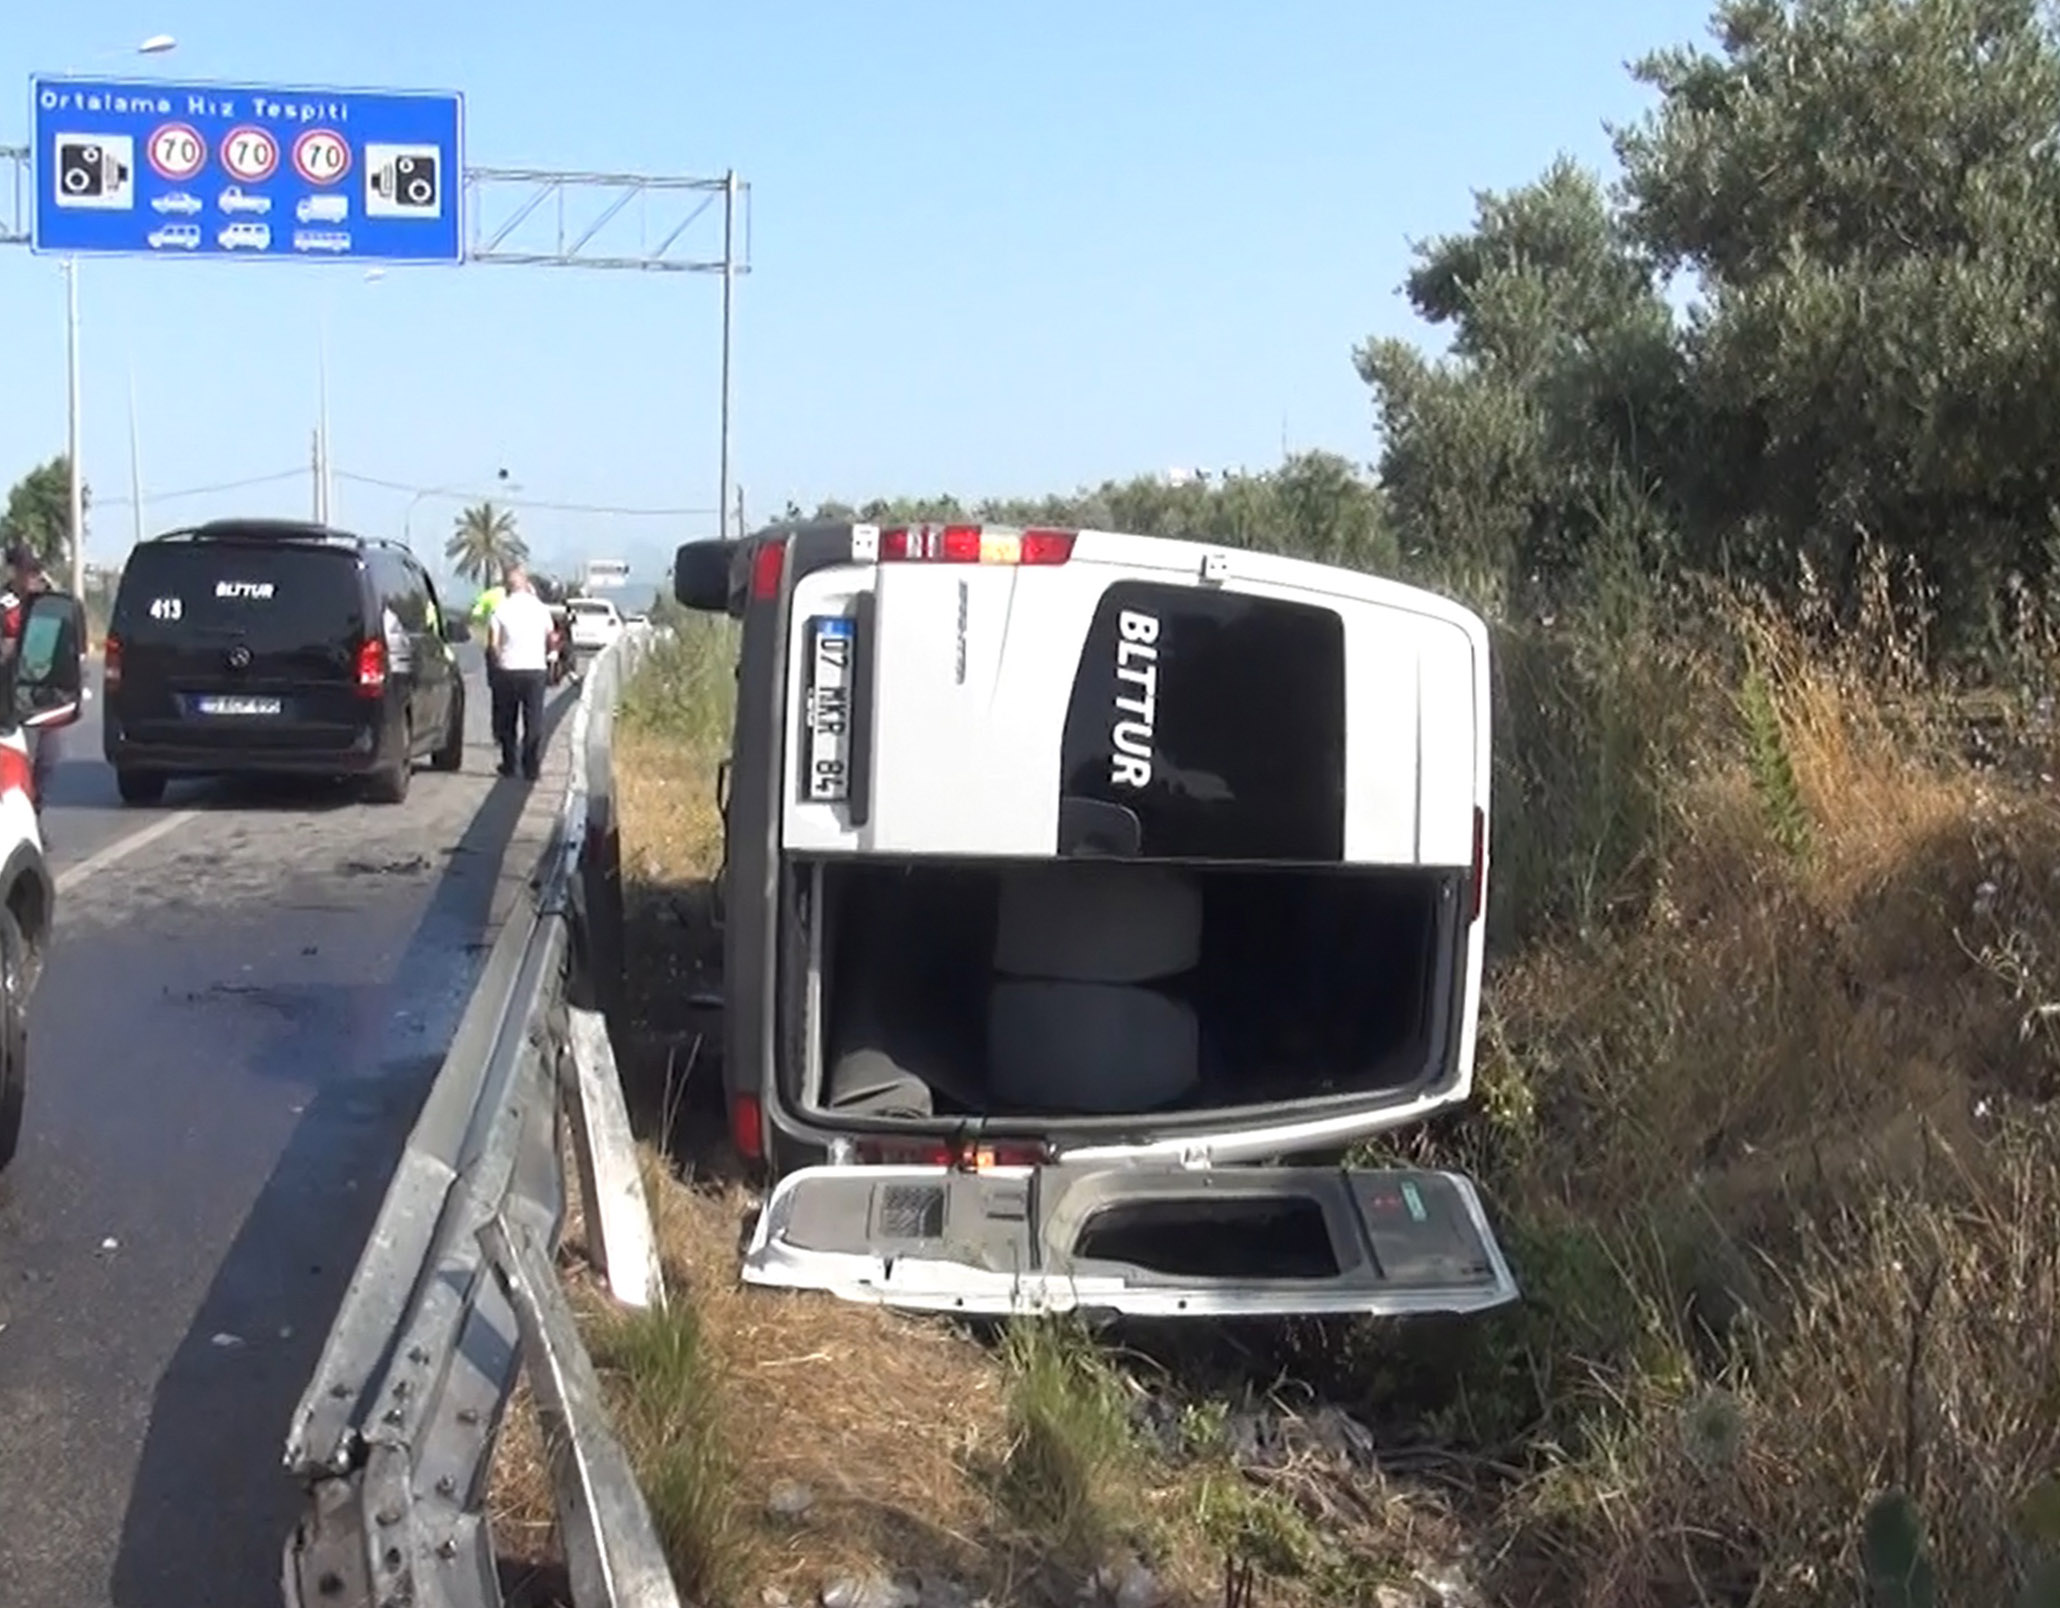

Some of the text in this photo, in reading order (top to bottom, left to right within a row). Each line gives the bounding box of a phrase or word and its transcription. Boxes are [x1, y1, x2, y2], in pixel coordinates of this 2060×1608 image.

[40, 90, 171, 112] Ortalama
[252, 97, 348, 123] Tespiti
[163, 138, 196, 163] 70
[236, 141, 268, 166] 70
[310, 144, 341, 168] 70
[150, 598, 182, 619] 413
[1111, 609, 1161, 789] BLTTUR
[815, 638, 849, 793] 07 MKR 84
